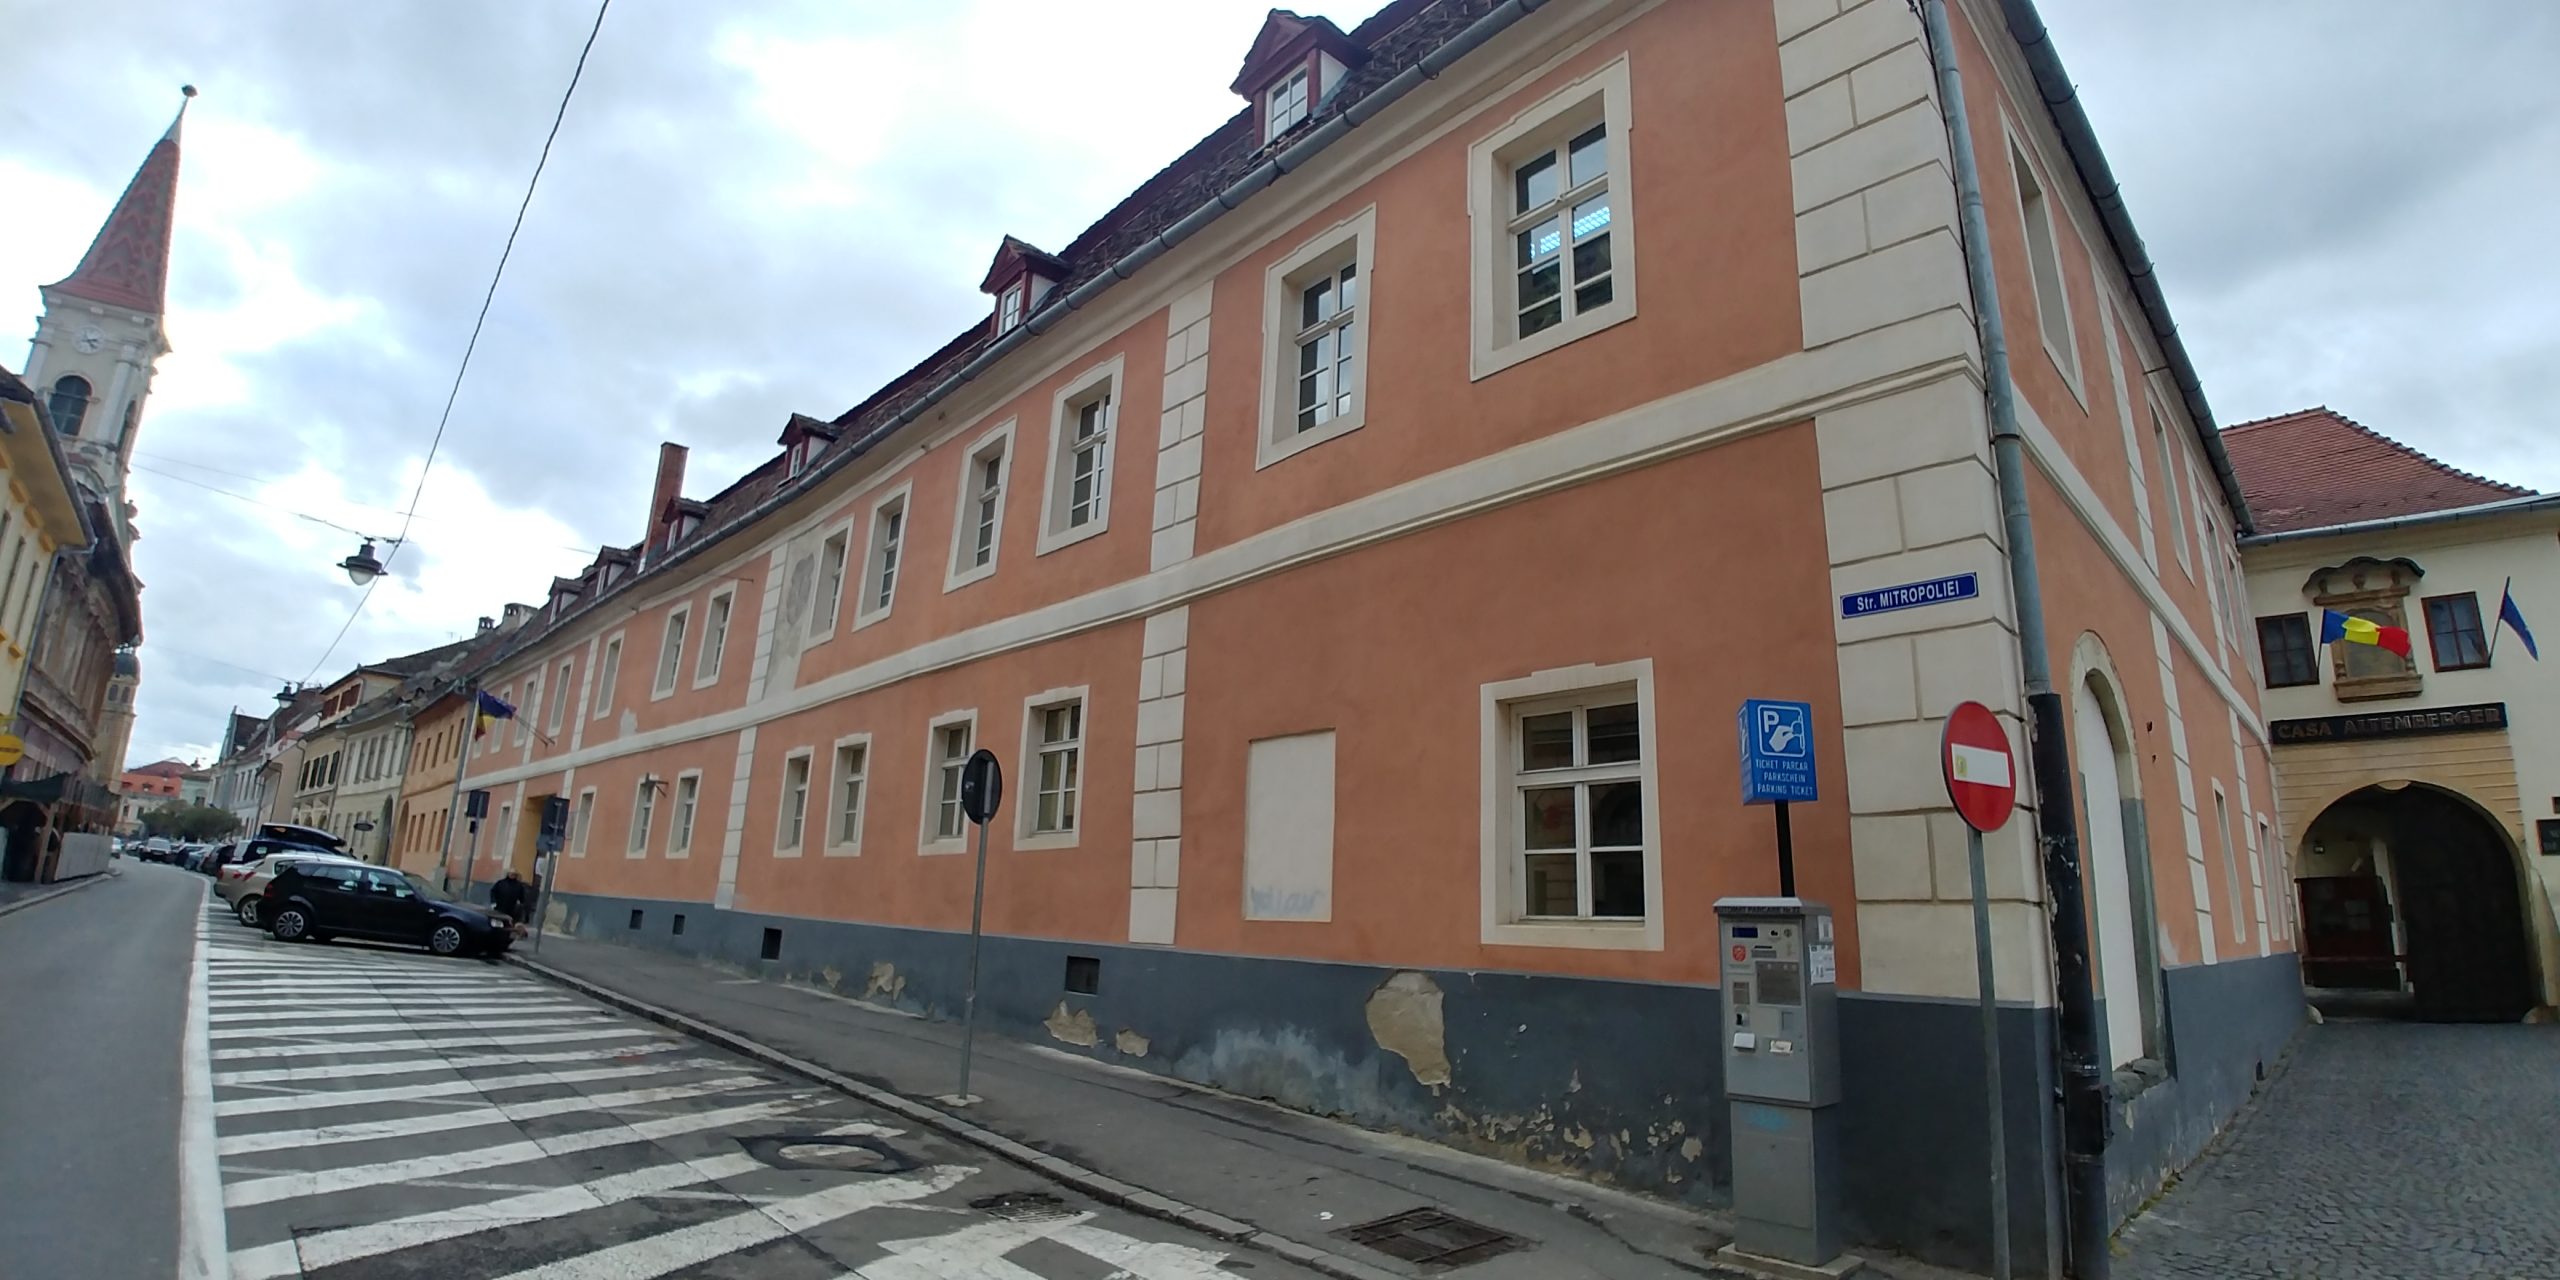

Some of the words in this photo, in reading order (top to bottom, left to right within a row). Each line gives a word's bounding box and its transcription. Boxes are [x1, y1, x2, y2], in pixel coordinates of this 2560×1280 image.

[1857, 596, 1877, 612] Str.
[1879, 580, 1960, 608] MITROPOLIEI
[1763, 710, 1780, 734] P
[2277, 721, 2333, 740] CASA
[2343, 707, 2501, 736] ALTEMBERGER
[1757, 783, 1787, 794] PARKING
[1763, 771, 1806, 783] PARKSCHEIN
